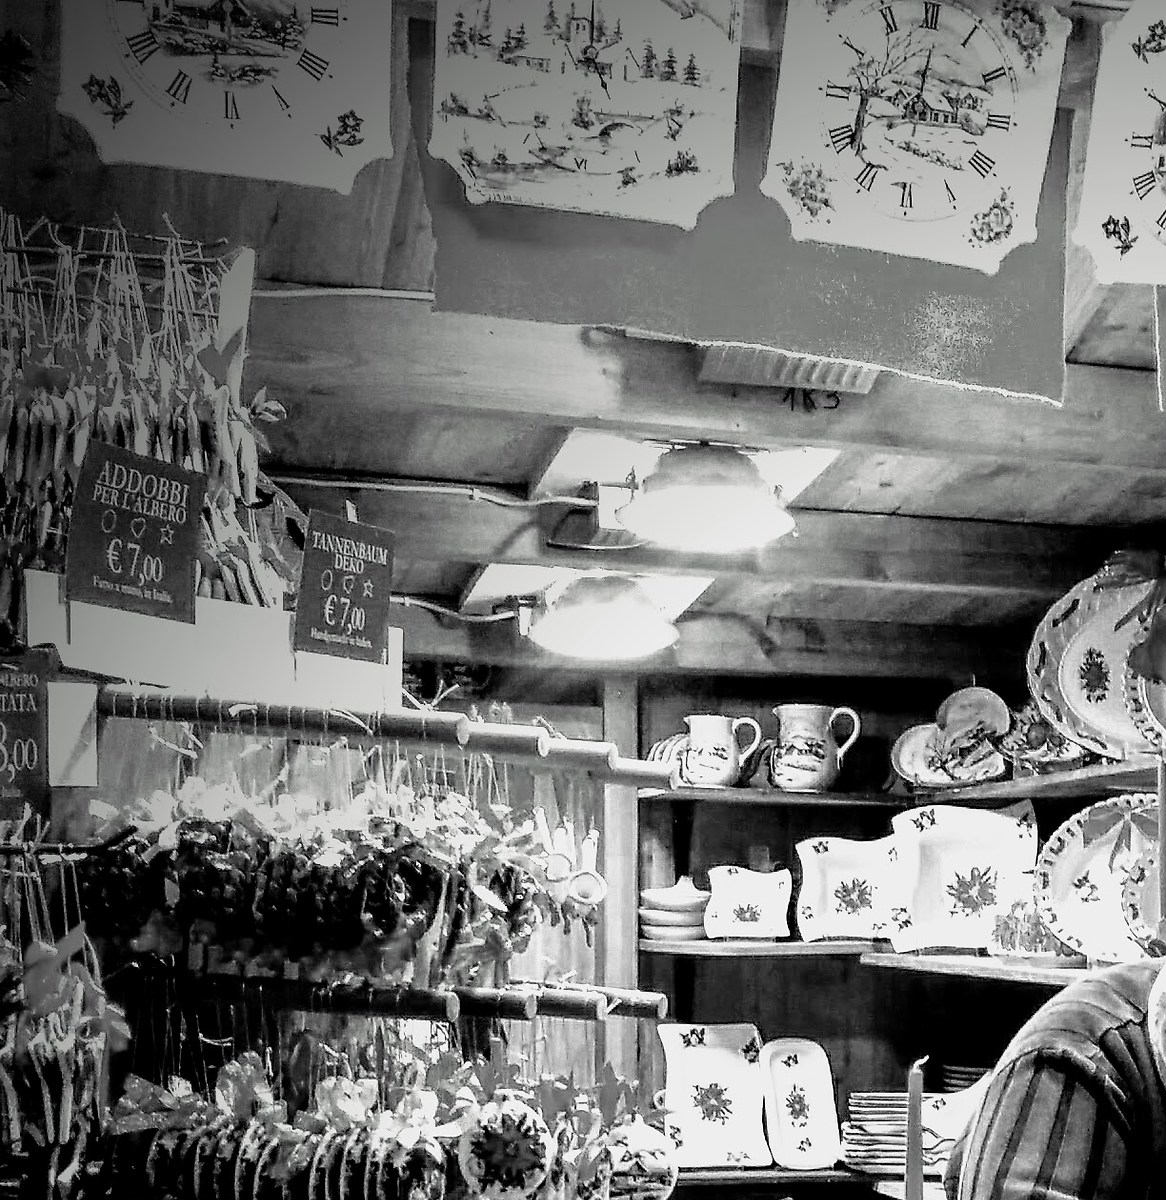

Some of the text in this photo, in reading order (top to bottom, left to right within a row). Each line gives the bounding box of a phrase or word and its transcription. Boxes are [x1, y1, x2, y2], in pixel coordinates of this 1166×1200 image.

[97, 461, 190, 508] ADDOBBI
[93, 484, 187, 524] PER L'ALBERO
[127, 542, 163, 587] 7,00
[312, 530, 388, 566] TANNENBAUM
[334, 553, 364, 574] DEKO
[340, 597, 366, 635] 7,00
[0, 693, 37, 712] TATA
